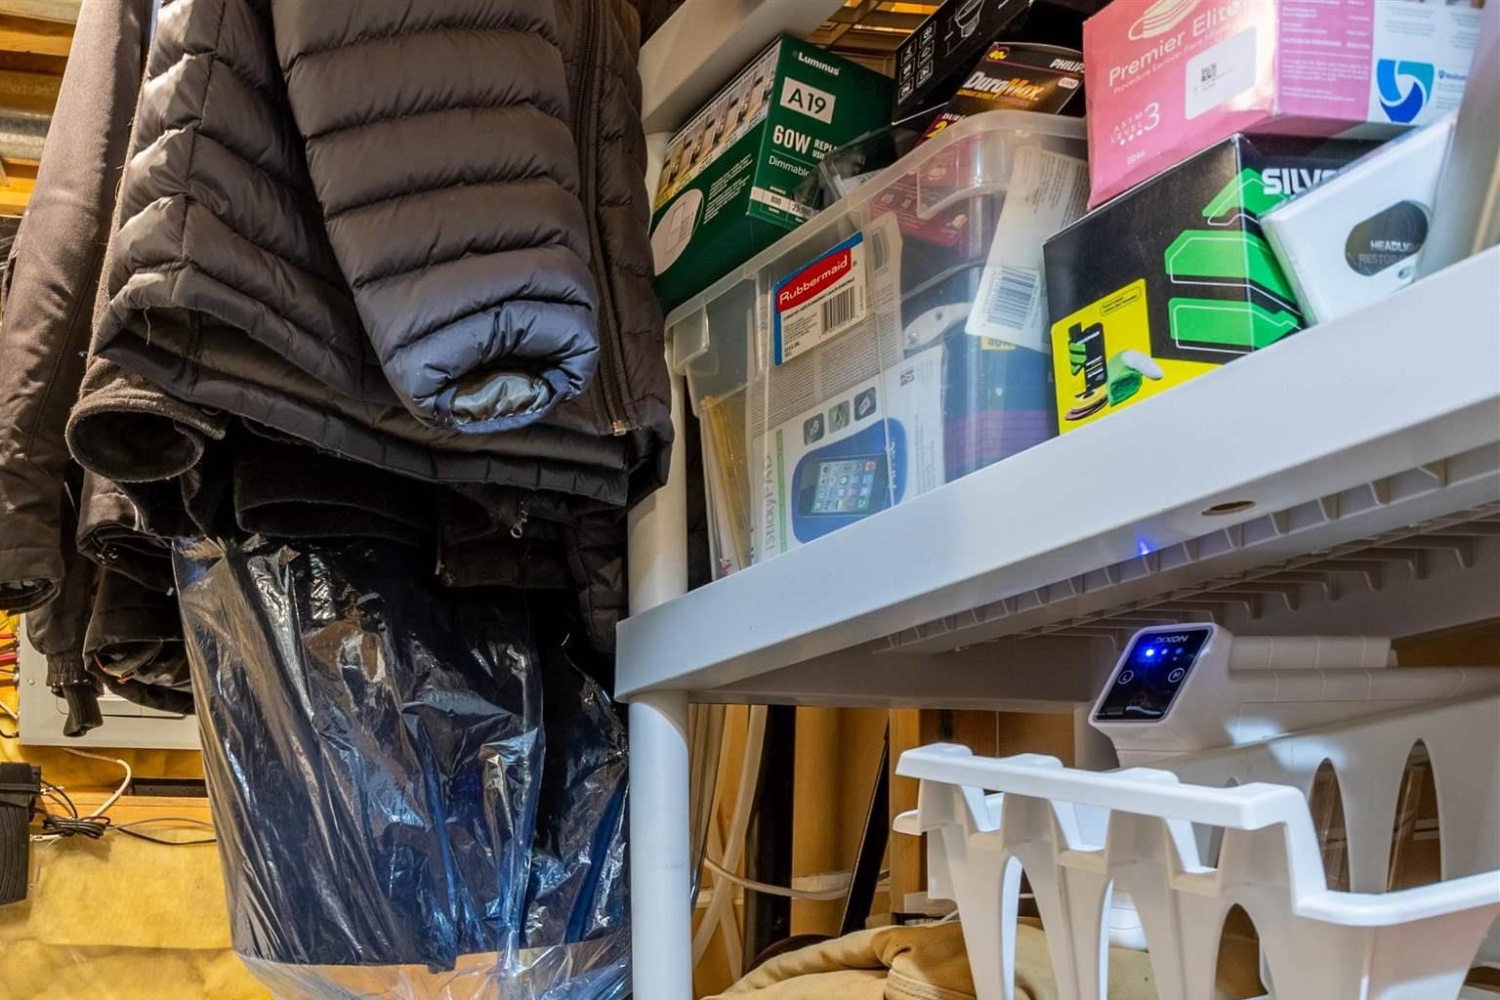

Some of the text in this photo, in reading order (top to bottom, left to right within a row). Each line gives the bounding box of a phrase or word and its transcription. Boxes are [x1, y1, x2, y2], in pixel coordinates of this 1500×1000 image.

[1109, 31, 1185, 87] Premier
[1192, 4, 1240, 37] Elite
[797, 51, 840, 76] Luminus
[788, 87, 827, 115] A19
[1145, 102, 1160, 131] 3
[772, 124, 811, 155] 60W
[779, 254, 849, 306] Rubbermaid
